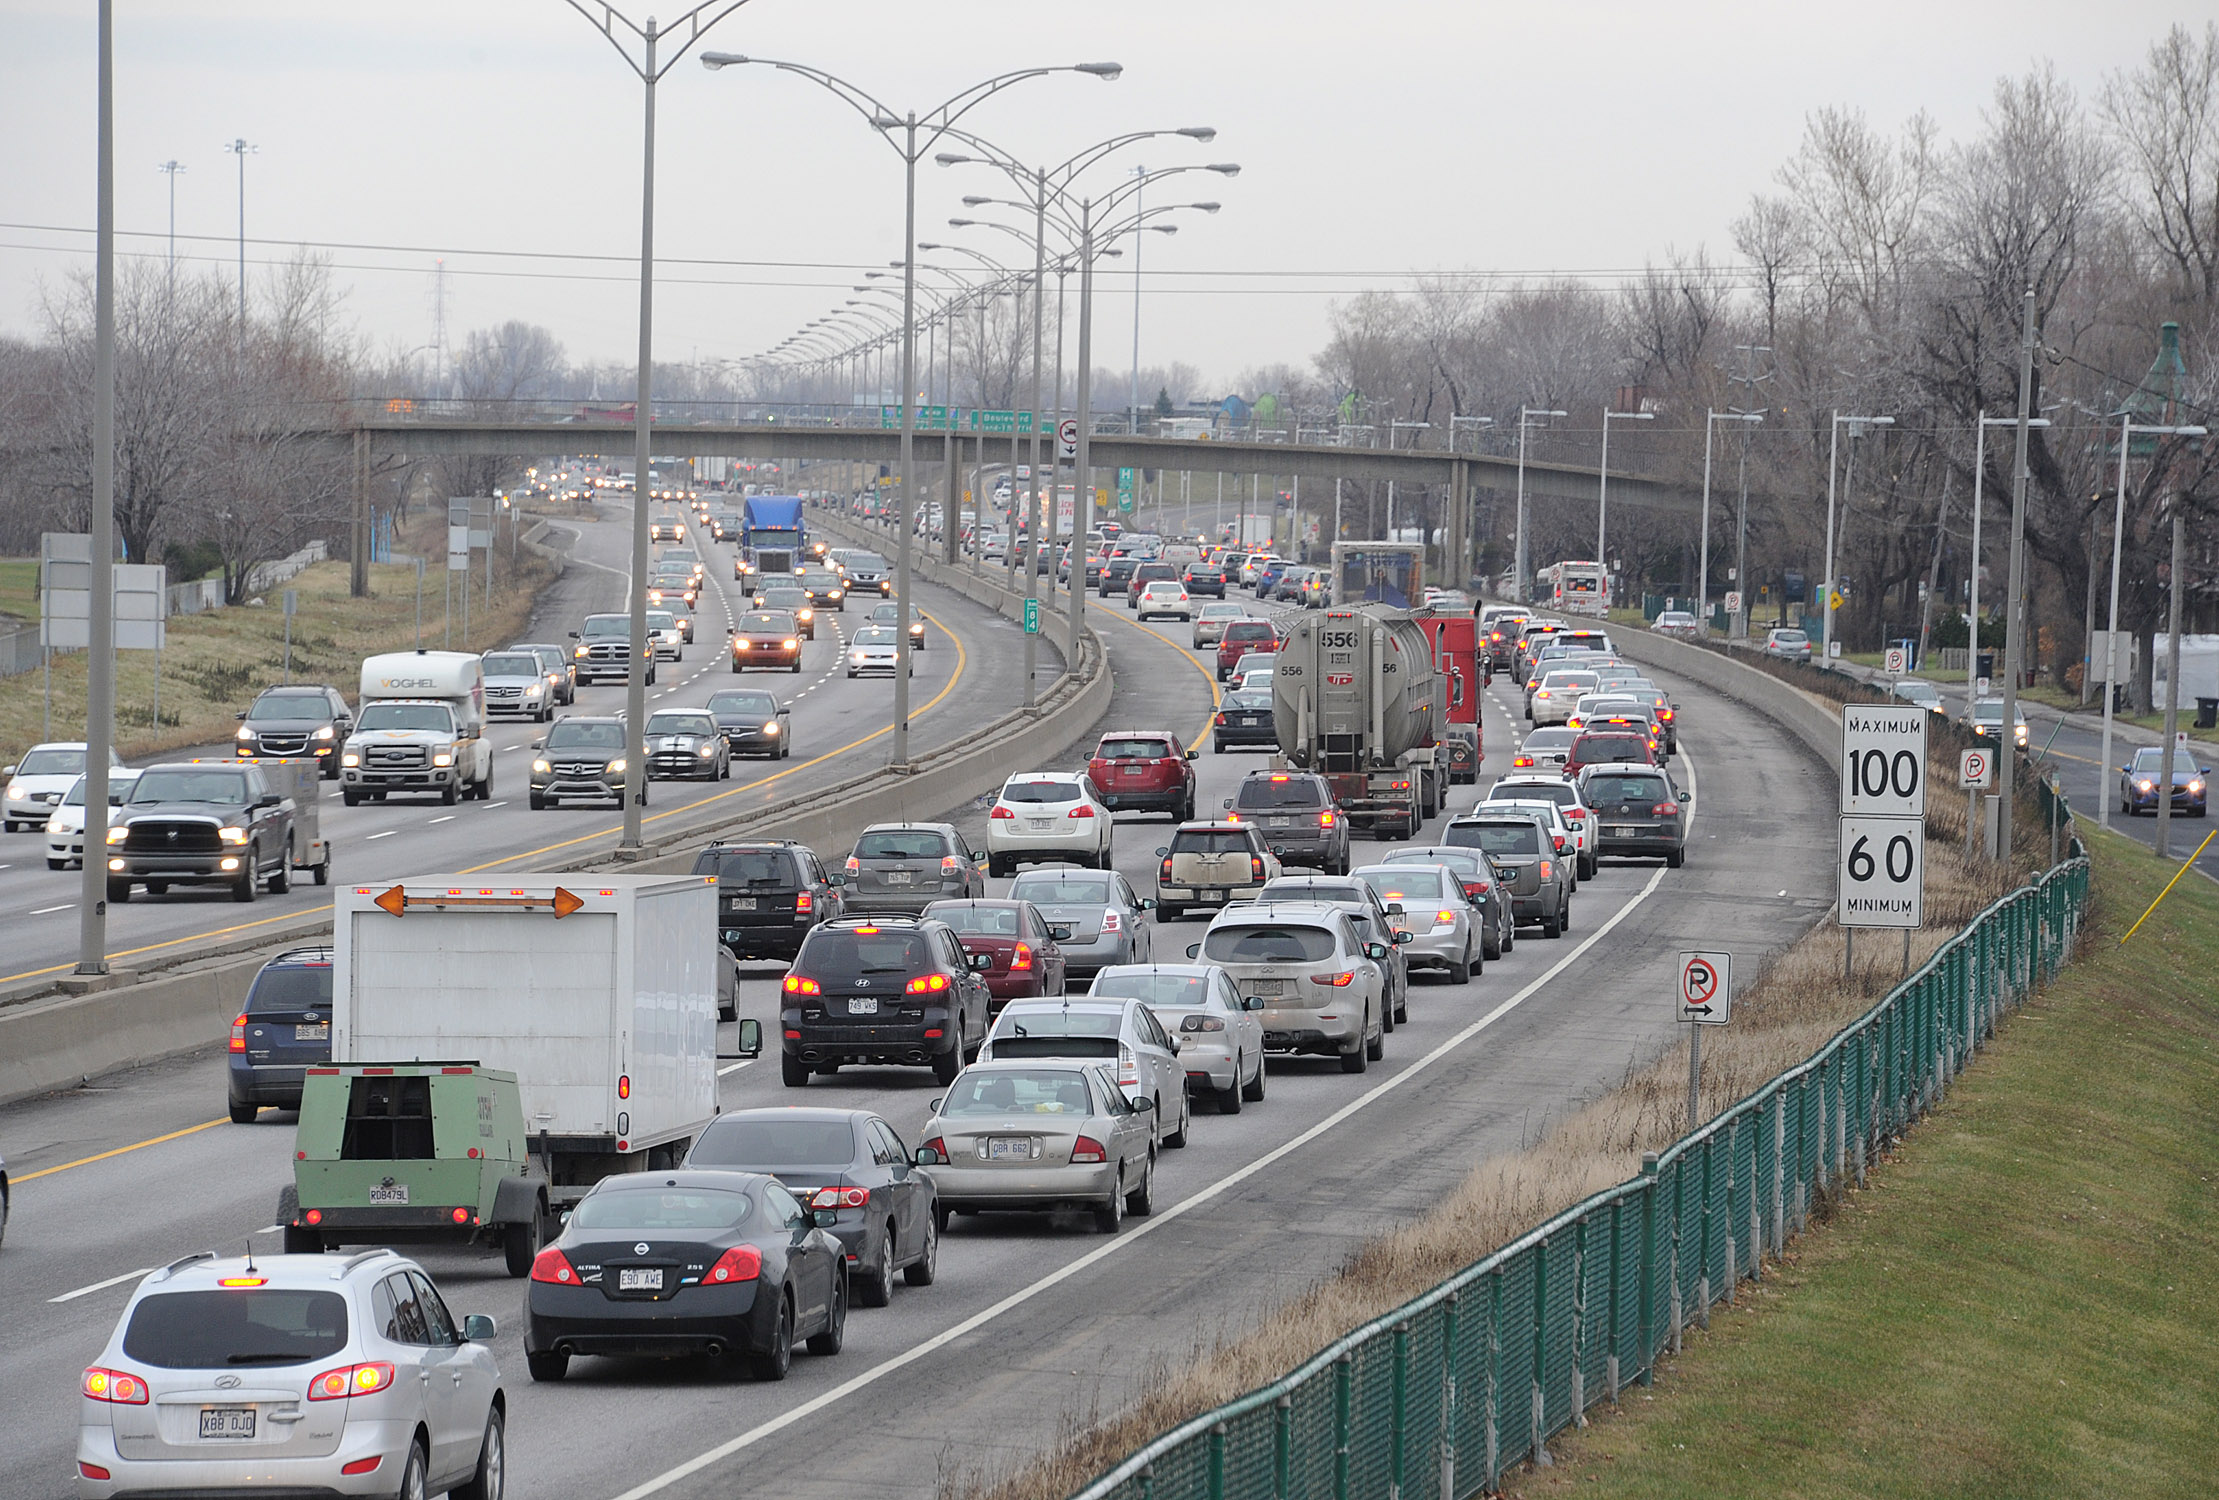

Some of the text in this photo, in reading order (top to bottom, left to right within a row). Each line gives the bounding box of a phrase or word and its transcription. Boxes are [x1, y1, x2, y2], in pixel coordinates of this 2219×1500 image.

[984, 414, 1029, 422] Boulevrd
[1321, 632, 1358, 648] 556
[1281, 666, 1303, 676] 556
[381, 679, 438, 688] VOGHEL
[1849, 719, 1920, 734] MAXIMUM
[1849, 749, 1919, 798] 100
[1848, 834, 1914, 883] 60
[1848, 898, 1912, 913] MINIMUM
[1013, 1144, 1027, 1153] 662
[621, 1274, 662, 1285] E90 AWE
[203, 1417, 253, 1431] X88 DJD
